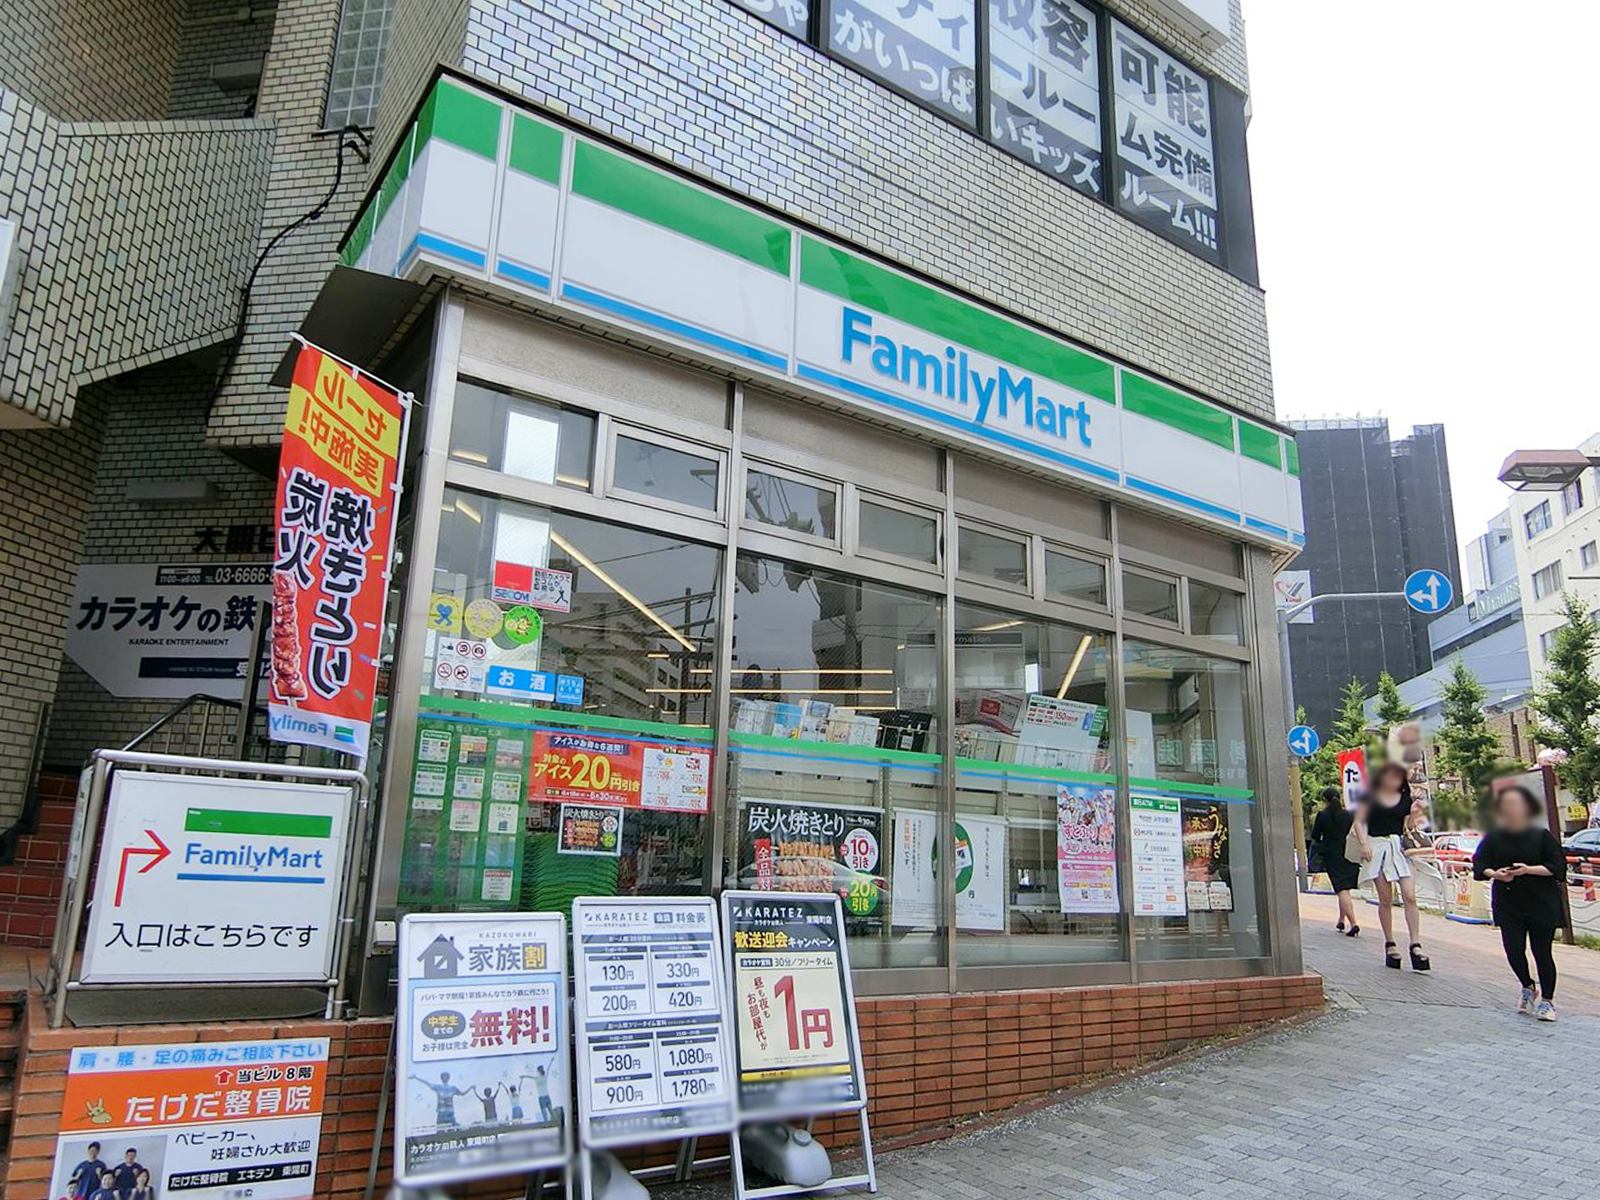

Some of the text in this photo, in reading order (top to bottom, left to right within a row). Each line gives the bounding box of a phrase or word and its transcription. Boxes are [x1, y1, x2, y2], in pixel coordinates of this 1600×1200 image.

[841, 306, 1092, 448] FamilyMart
[494, 589, 530, 602] SECOM
[128, 638, 230, 646] KARAOKE ENTERTAINMENT
[498, 669, 547, 692] お酒
[748, 806, 845, 838] 炭火焼きとり
[184, 841, 323, 872] FamilyMart
[851, 855, 870, 870] 引き
[745, 906, 803, 919] KARATEZ
[851, 897, 870, 912] 引き
[595, 912, 648, 922] KARATEZ
[104, 921, 320, 949] 入口はこちらです
[479, 931, 538, 939] KAZOKUWARI
[468, 943, 547, 972] 家族割
[602, 964, 635, 981] 130円
[666, 962, 701, 980] 330円
[602, 994, 637, 1012] 200円
[668, 991, 703, 1008] 420円
[773, 975, 834, 1051] 1円
[469, 1005, 551, 1048] 無料!
[605, 1053, 641, 1073] 580円
[669, 1047, 713, 1068] 1,080円
[124, 1085, 313, 1124] たけだ整骨院
[606, 1084, 643, 1105] 900円
[211, 1139, 312, 1162] 妊婦さん大歓迎
